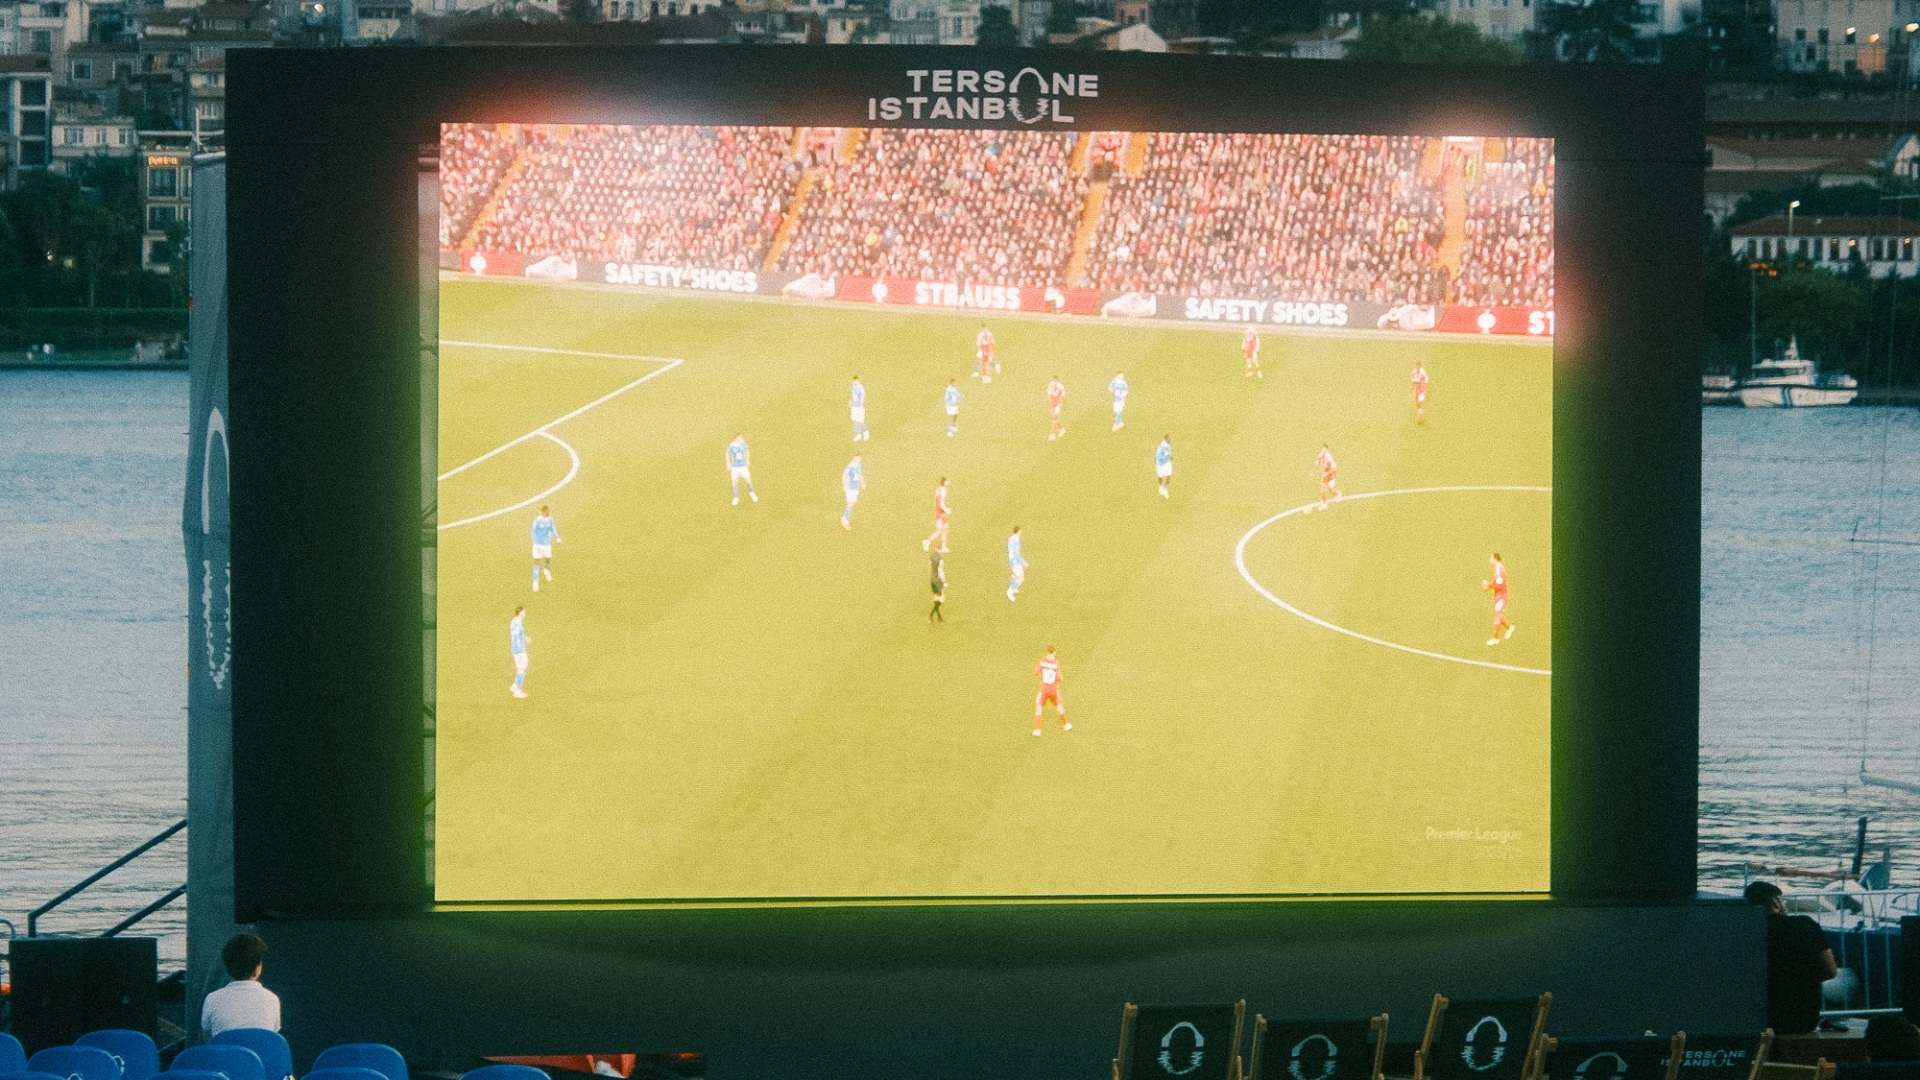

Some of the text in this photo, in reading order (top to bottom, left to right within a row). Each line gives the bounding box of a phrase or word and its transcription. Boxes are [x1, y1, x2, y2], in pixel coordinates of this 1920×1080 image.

[868, 97, 1075, 124] ISTANBUL
[604, 262, 758, 293] SAFETY SHOES
[915, 281, 1021, 310] STRAUSS
[1185, 297, 1349, 326] SAFETY SHOES
[1425, 826, 1522, 844] Premier League
